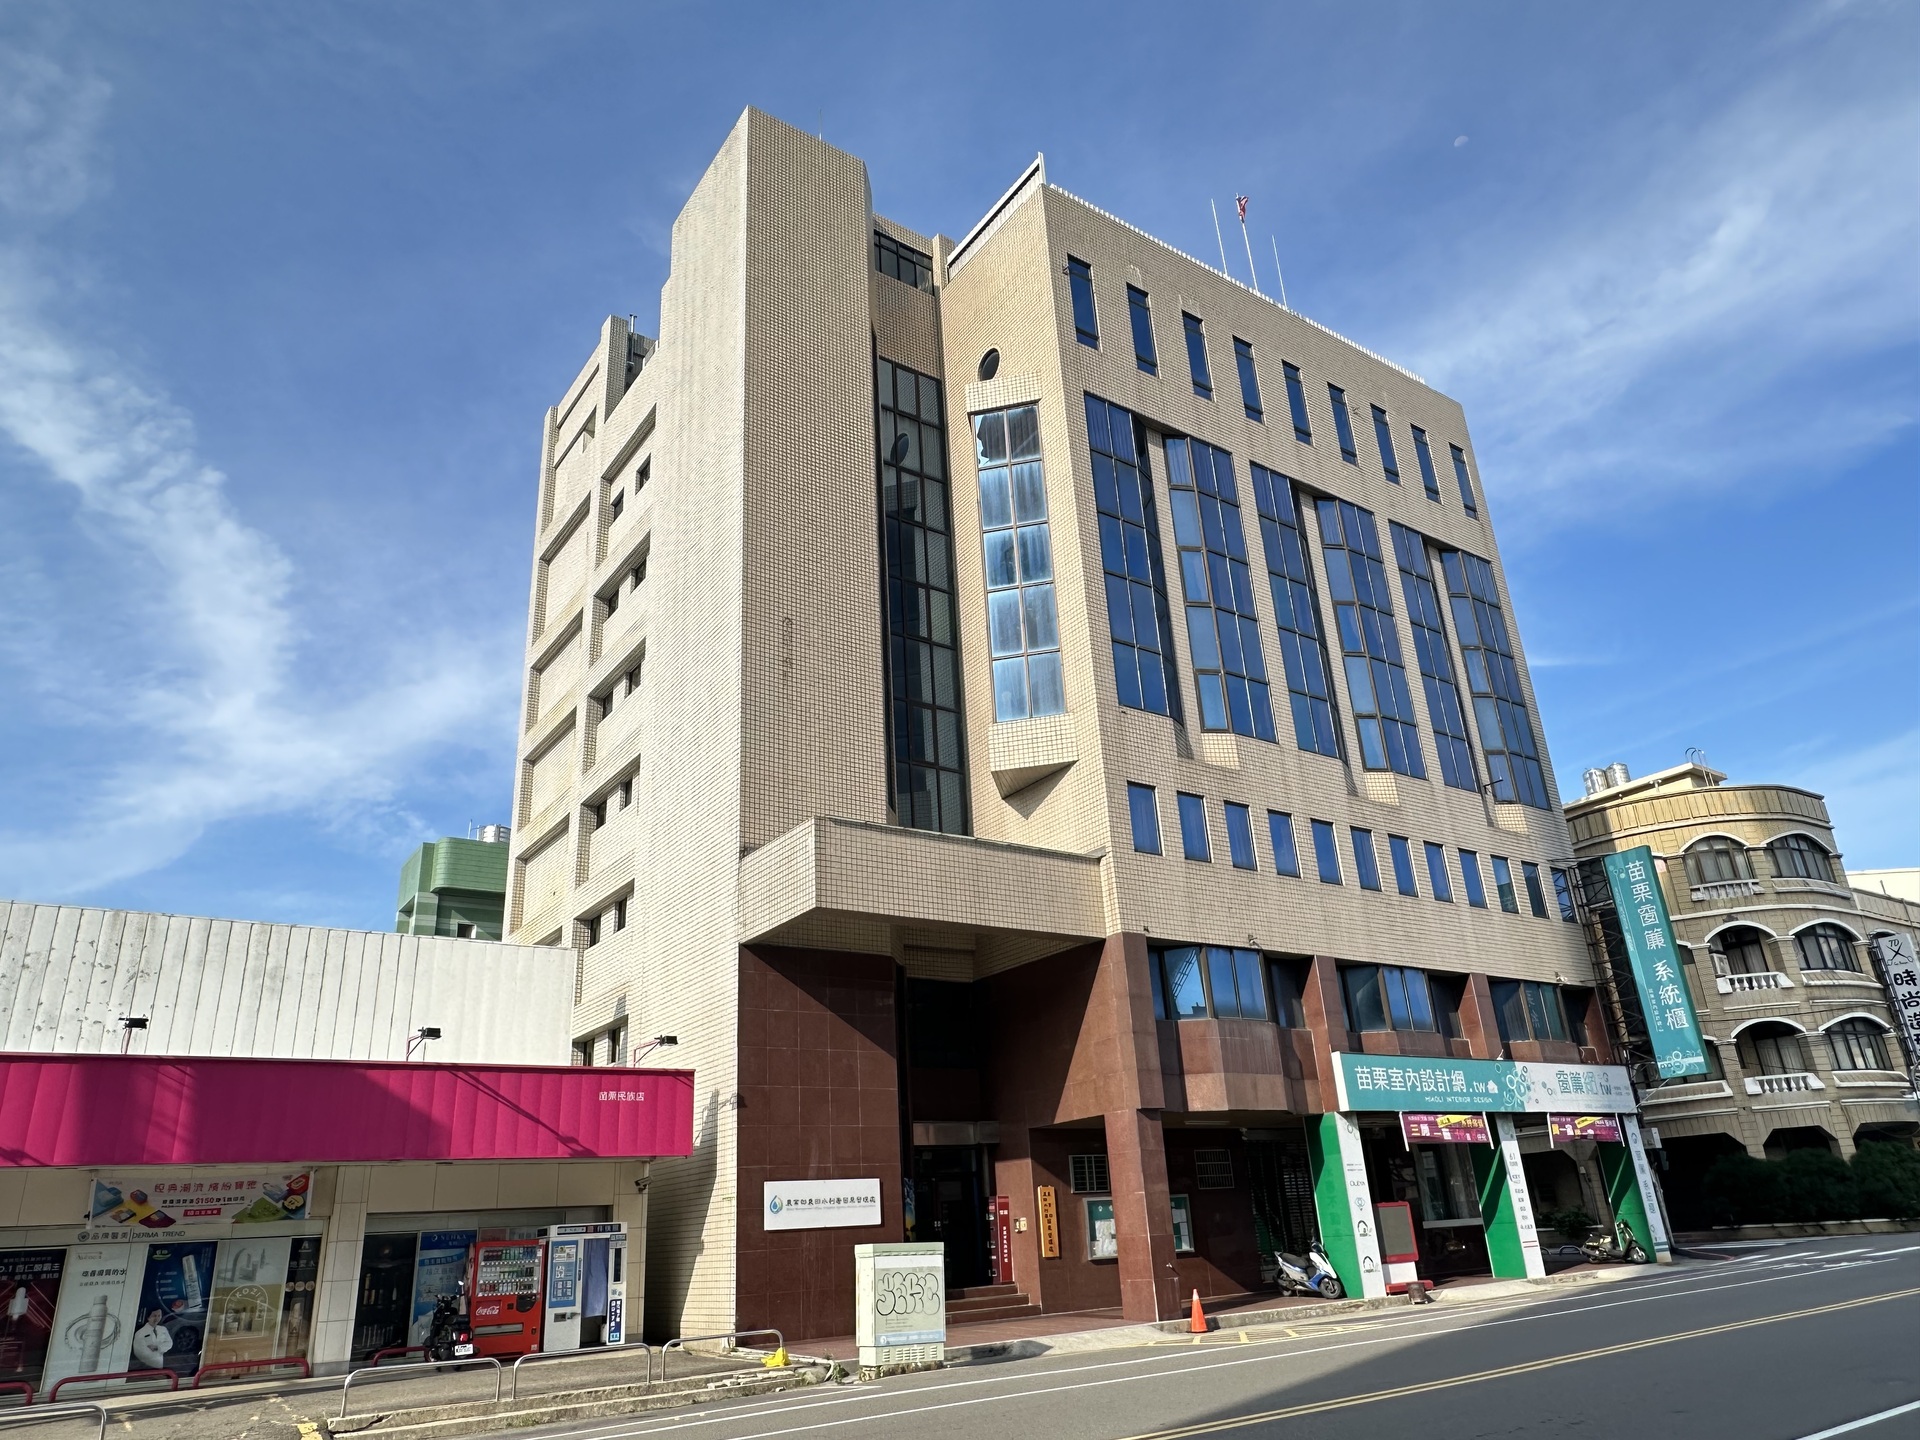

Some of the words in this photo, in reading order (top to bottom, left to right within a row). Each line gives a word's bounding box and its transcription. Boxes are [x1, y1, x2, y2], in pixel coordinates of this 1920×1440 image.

[1625, 860, 1666, 950] 苗栗窗簾
[1653, 959, 1689, 1030] 系統櫃
[162, 1230, 186, 1238] TREND
